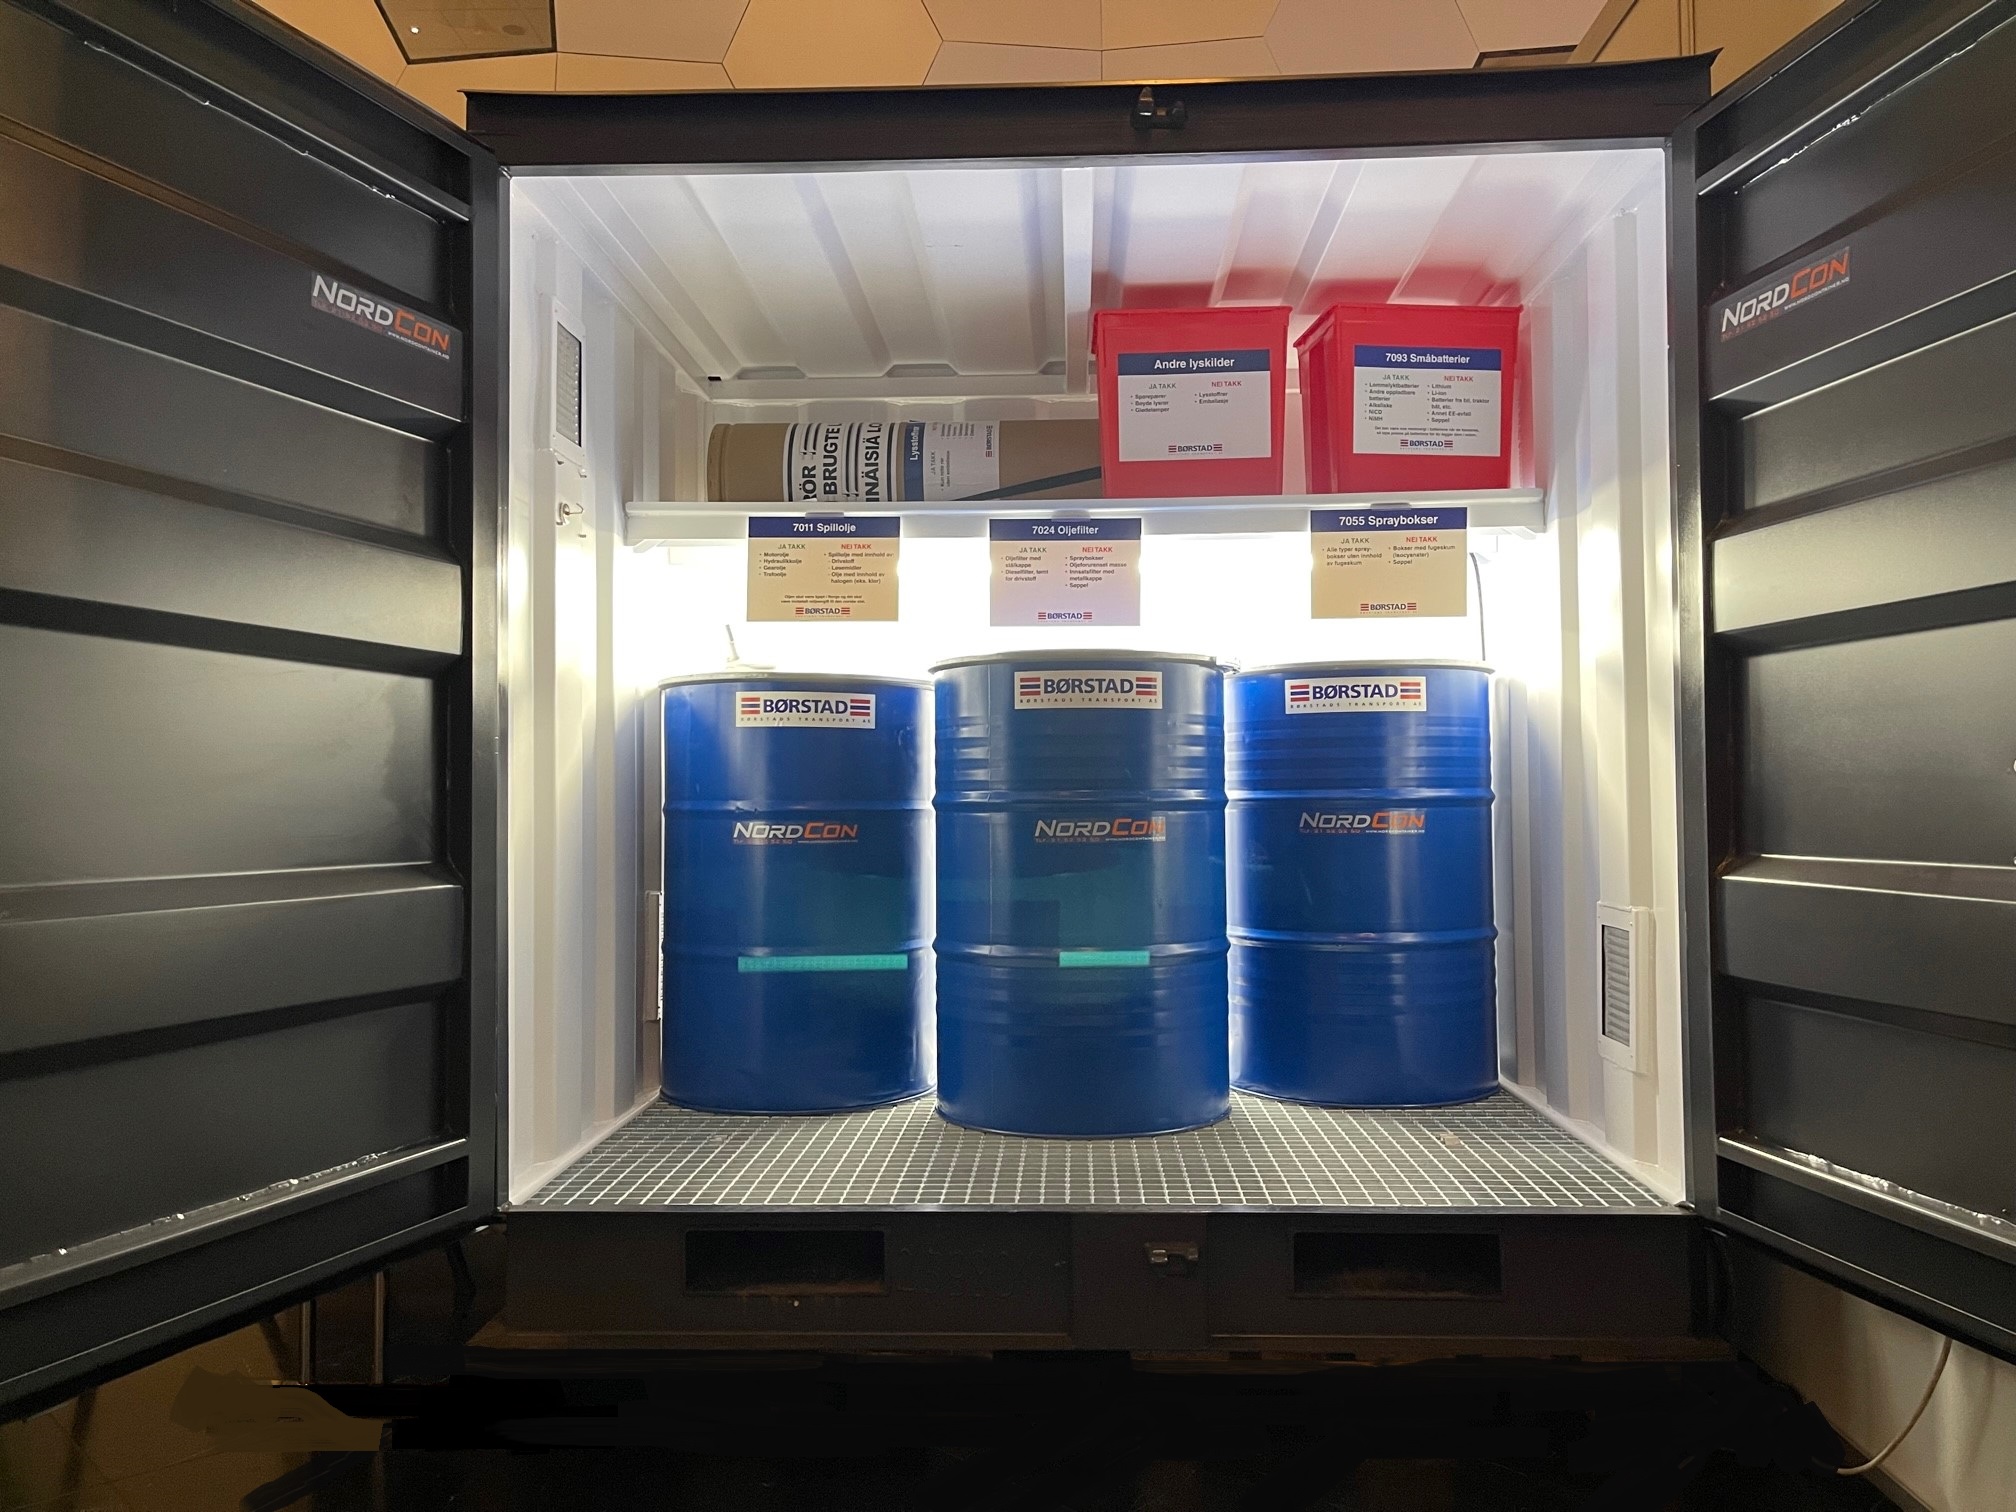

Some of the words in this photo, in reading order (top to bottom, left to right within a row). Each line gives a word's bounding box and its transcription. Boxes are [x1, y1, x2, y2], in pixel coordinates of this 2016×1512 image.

[1154, 359, 1186, 369] Andre
[1189, 358, 1234, 370] lyskilder
[1386, 354, 1407, 362] 7093
[1410, 353, 1470, 364] Småbatterier
[1178, 444, 1213, 452] BØRSTAD
[823, 428, 840, 494] BRUGTE
[931, 467, 936, 475] JA
[1339, 517, 1365, 526] 7055
[1368, 515, 1438, 527] Spraybokser
[793, 524, 813, 532] 7011
[817, 523, 856, 534] Spillolje
[1032, 526, 1055, 534] 7024
[1058, 526, 1098, 536] Oljefilter
[1048, 612, 1082, 620] BØRSTAD
[1043, 678, 1134, 694] BØRSTAD
[1312, 684, 1398, 700] BØRSTAD
[763, 699, 848, 715] BØRSTAD
